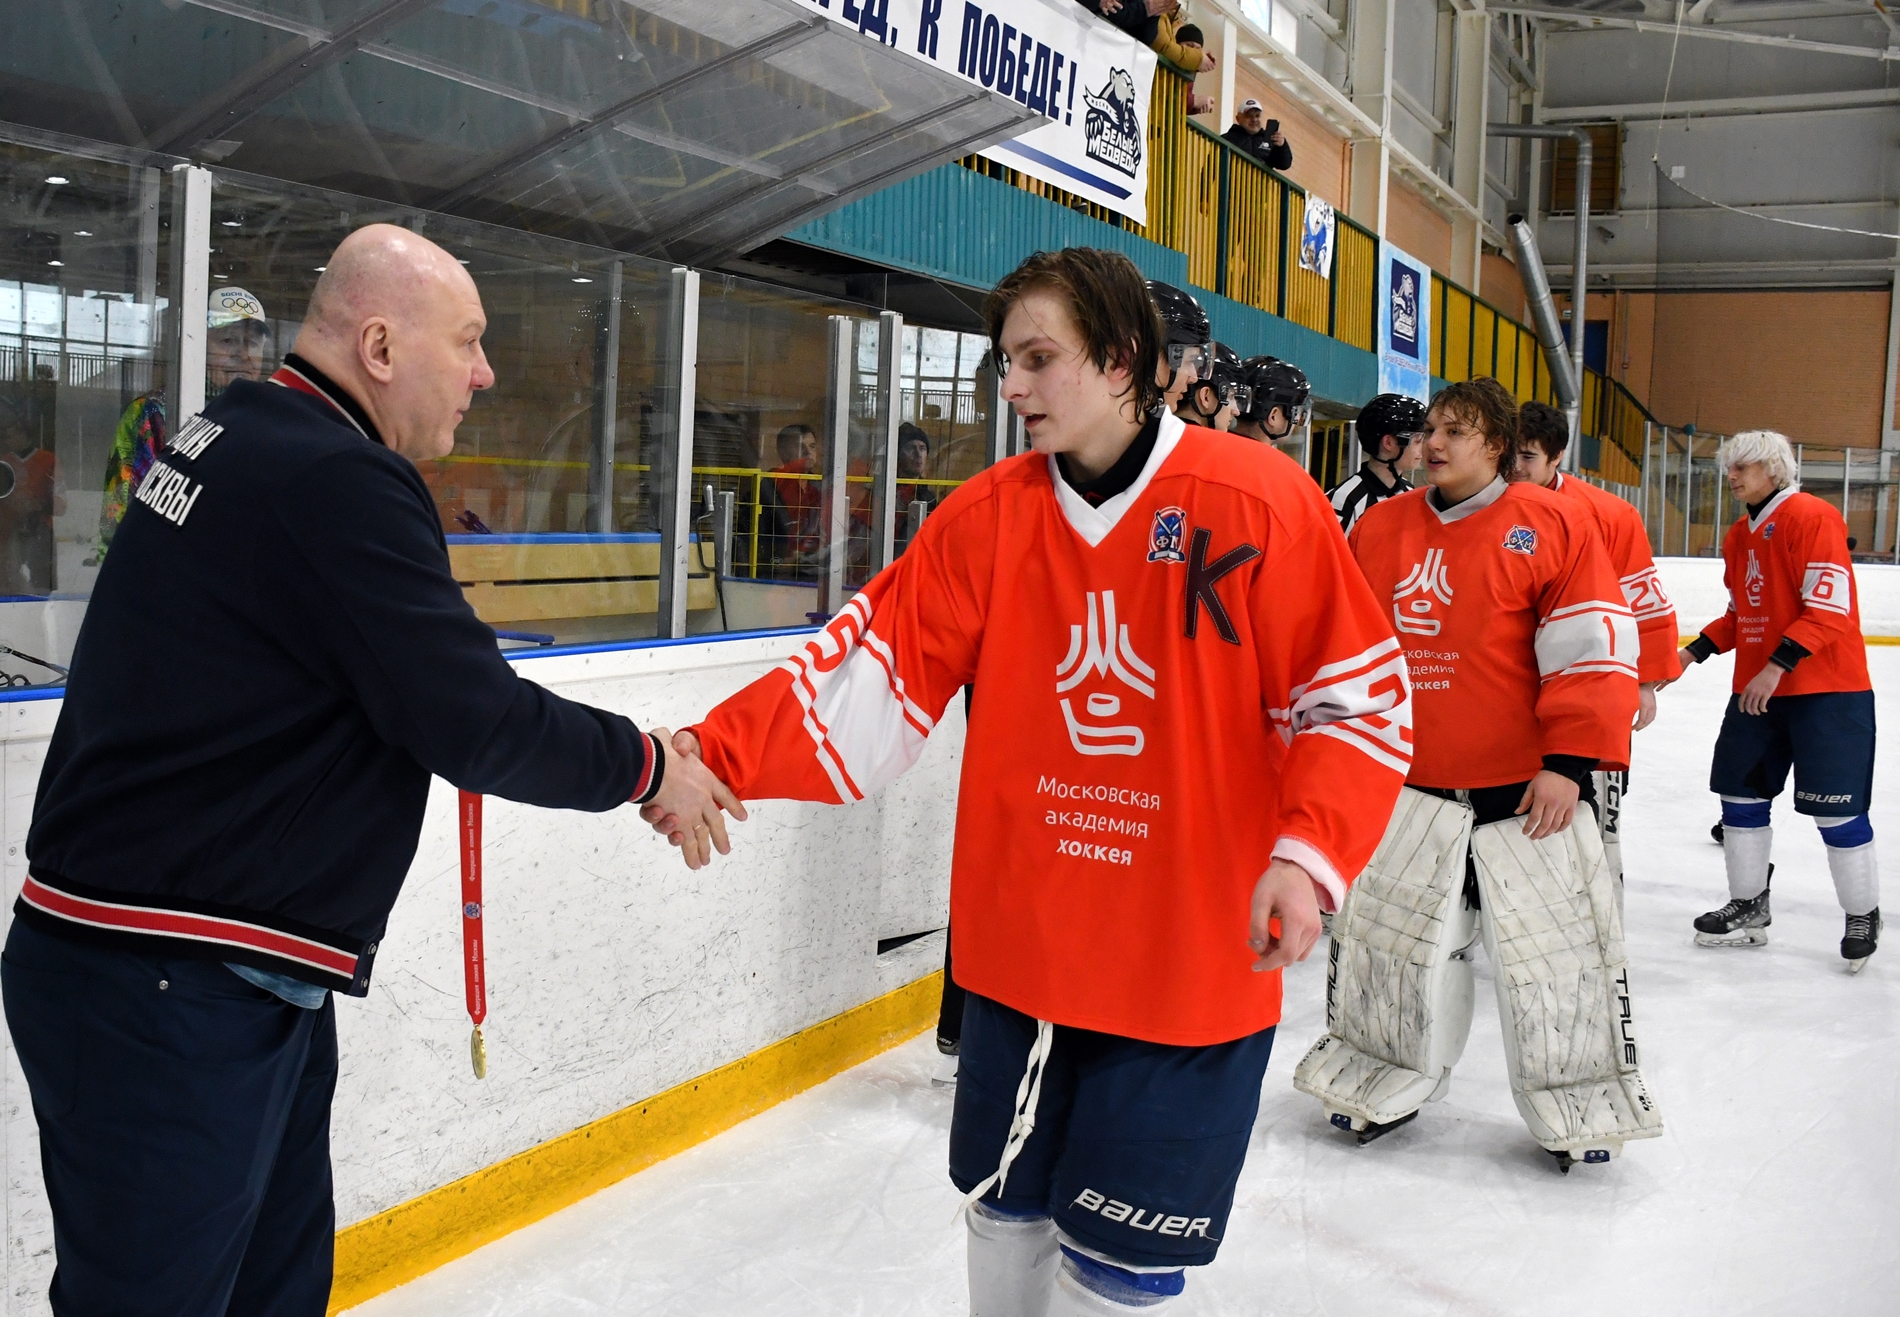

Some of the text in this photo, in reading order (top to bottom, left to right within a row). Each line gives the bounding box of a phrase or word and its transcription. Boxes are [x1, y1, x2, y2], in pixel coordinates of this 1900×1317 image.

[958, 0, 1077, 126] ПОБЕДЕ!
[1629, 577, 1668, 611] 20
[1812, 571, 1834, 600] 6
[1602, 615, 1616, 657] 1
[1402, 649, 1460, 661] сковская
[1406, 665, 1455, 676] адемия
[1410, 679, 1450, 690] оккея
[1036, 774, 1161, 811] Московская
[1796, 790, 1853, 805] BAUER
[1044, 809, 1149, 839] академия
[1056, 837, 1133, 866] хоккея
[1327, 937, 1340, 1027] TRUE
[1614, 967, 1638, 1066] TRUE
[1074, 1187, 1211, 1238] BAUER
